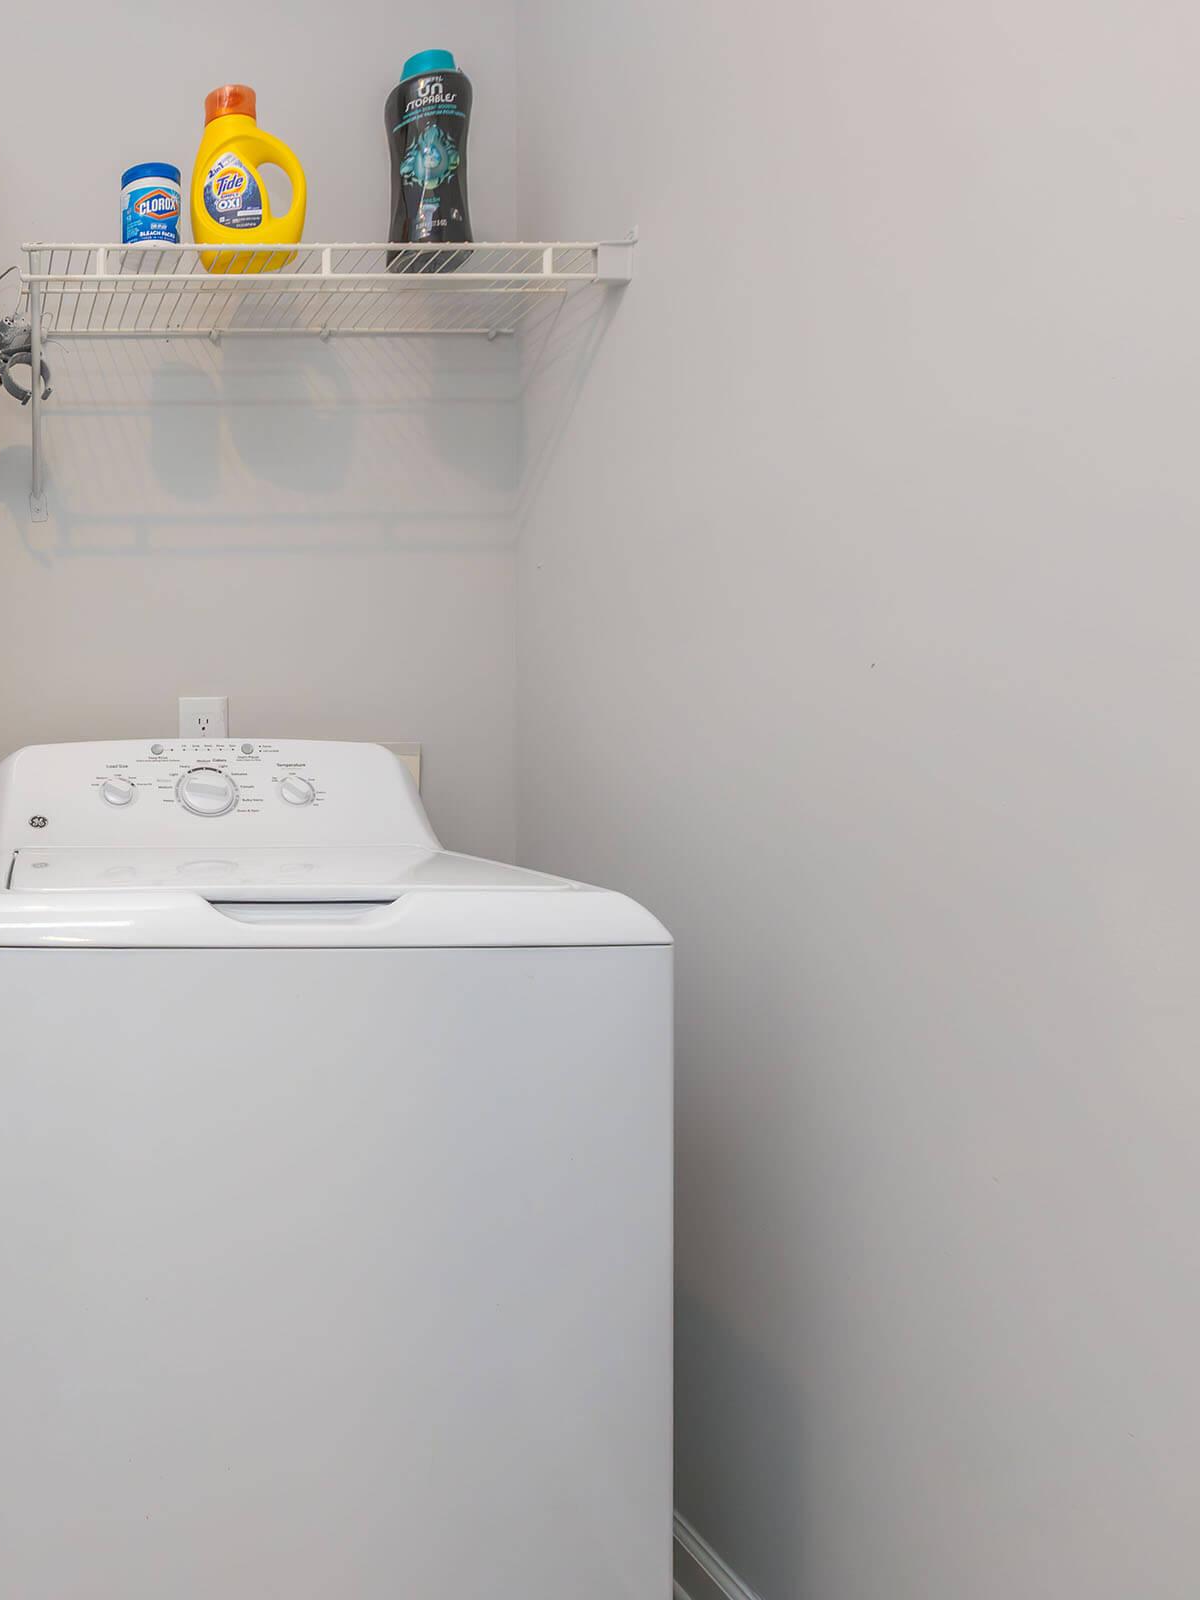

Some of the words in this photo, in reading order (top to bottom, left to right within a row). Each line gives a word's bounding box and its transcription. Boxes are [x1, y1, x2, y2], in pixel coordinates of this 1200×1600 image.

[405, 93, 457, 112] STOPABLES
[217, 173, 244, 196] Tide
[140, 197, 177, 215] CLOROX
